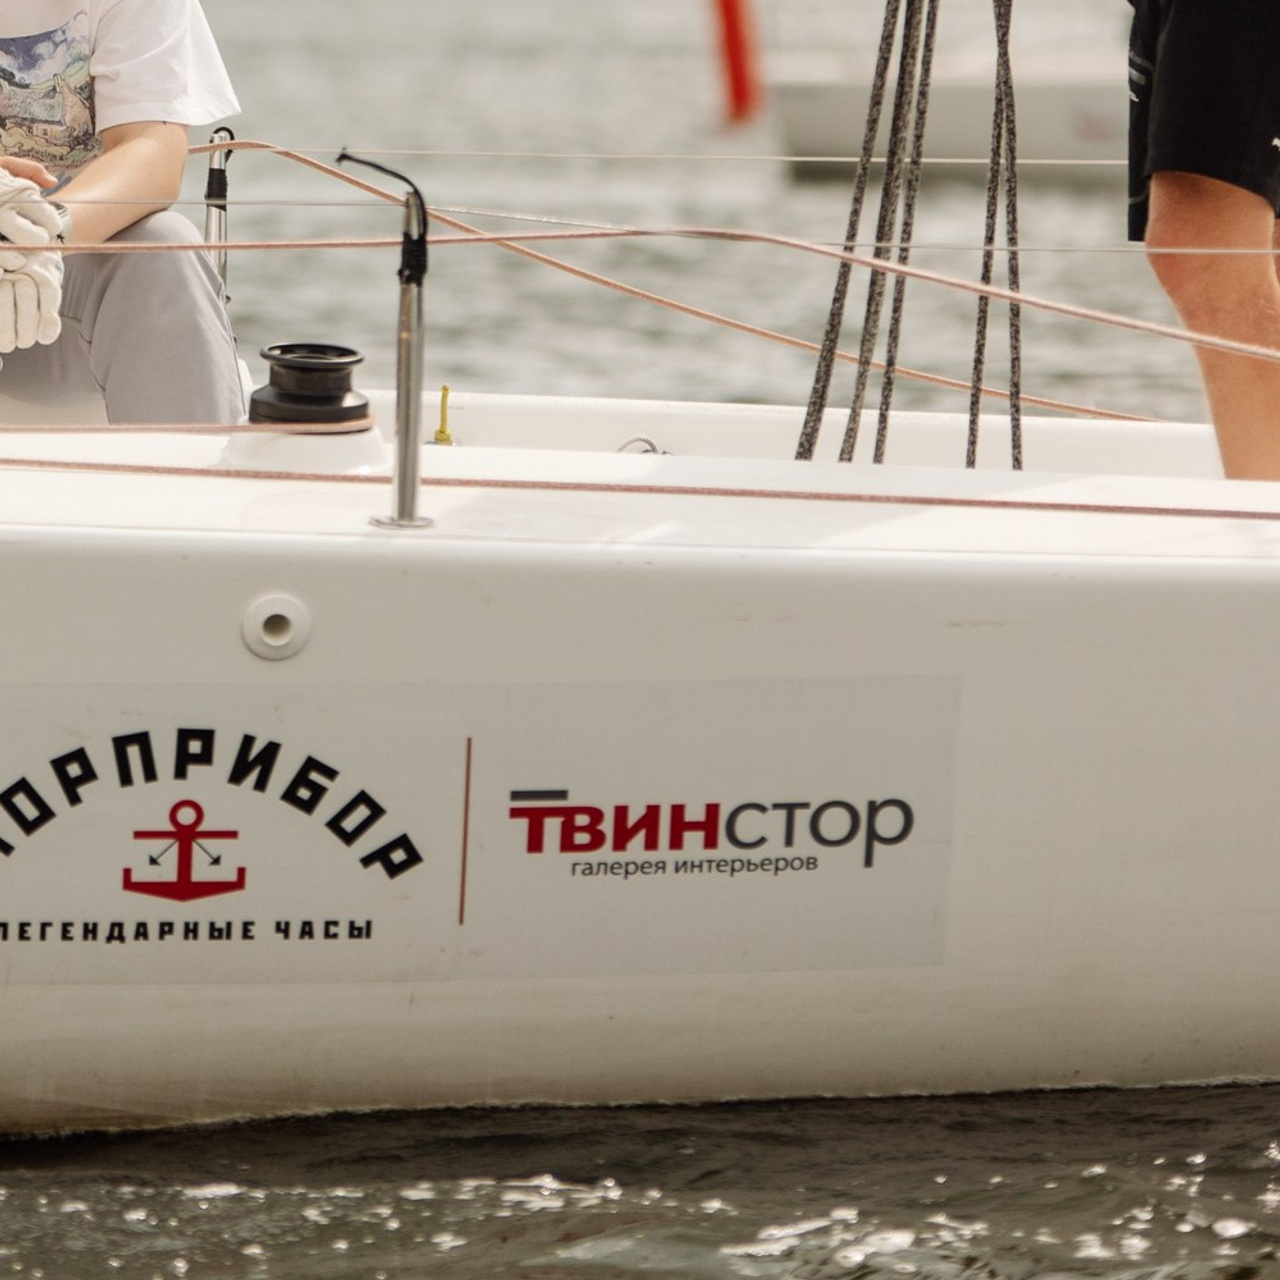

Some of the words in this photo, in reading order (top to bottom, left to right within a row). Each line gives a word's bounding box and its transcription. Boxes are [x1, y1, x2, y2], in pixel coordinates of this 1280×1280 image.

[570, 859, 667, 881] галерея
[674, 855, 819, 879] интерьеров
[275, 919, 374, 942] ЧАСЫ
